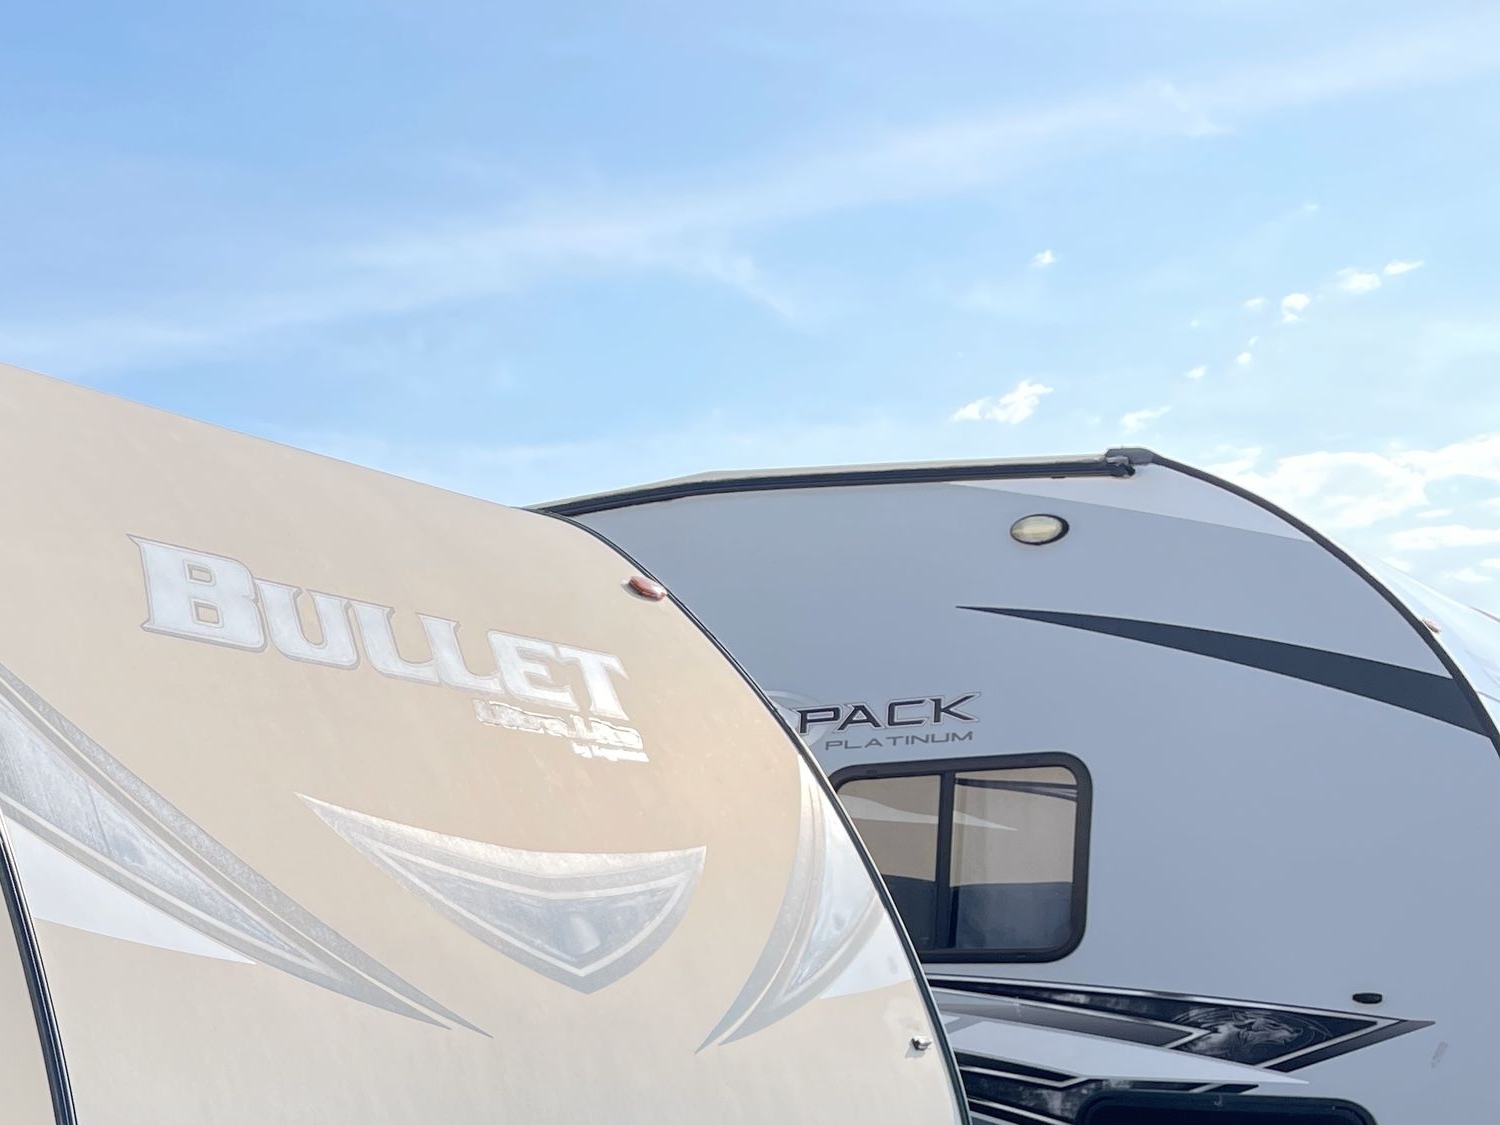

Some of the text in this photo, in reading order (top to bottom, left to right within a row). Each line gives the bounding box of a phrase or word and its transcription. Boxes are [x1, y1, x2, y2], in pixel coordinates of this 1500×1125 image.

[126, 534, 629, 720] BULLET
[793, 692, 981, 736] PACK
[825, 731, 973, 750] PLATINUM
